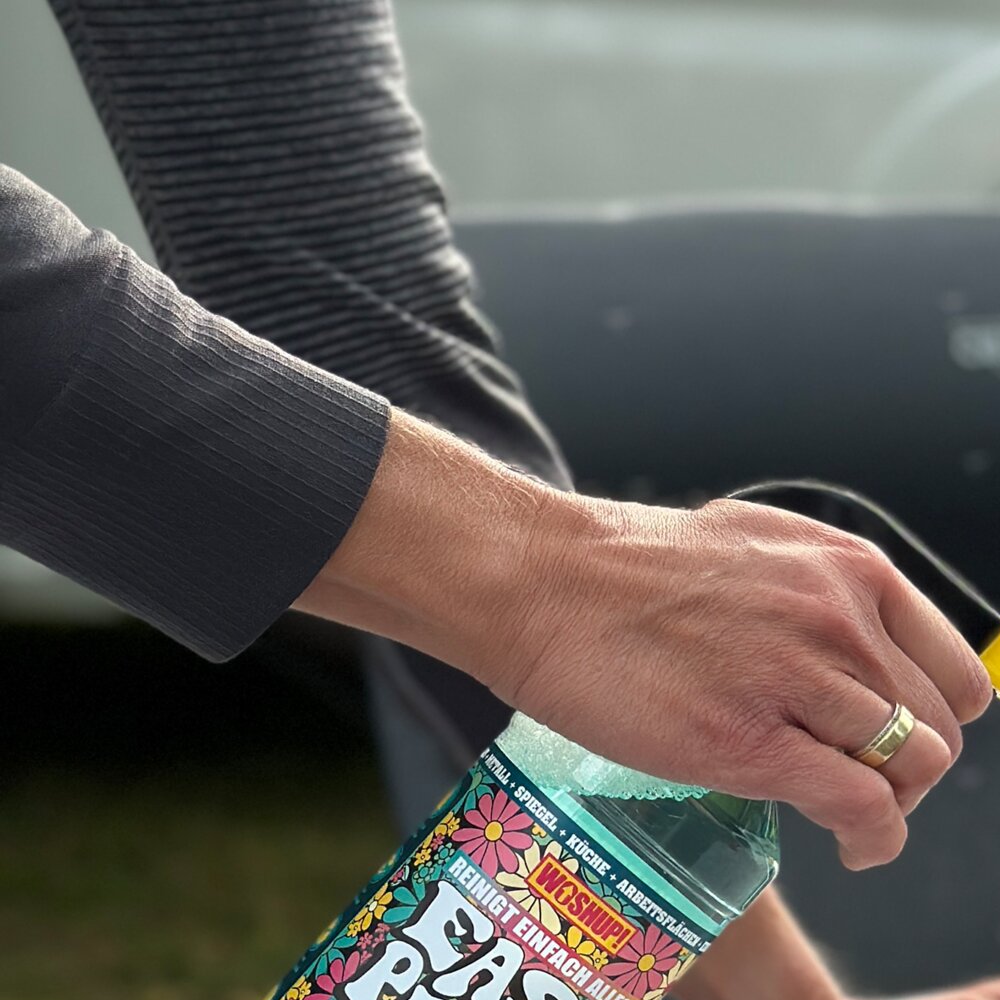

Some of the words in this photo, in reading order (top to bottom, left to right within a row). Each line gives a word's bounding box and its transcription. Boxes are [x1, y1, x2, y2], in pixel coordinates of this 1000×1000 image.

[449, 857, 520, 930] REINIGT
[512, 918, 591, 986] EINFACH
[513, 785, 557, 832] SPIEGEL
[566, 834, 612, 877] KÜCHE
[615, 877, 701, 946] ARBEITSFLÄCHEN
